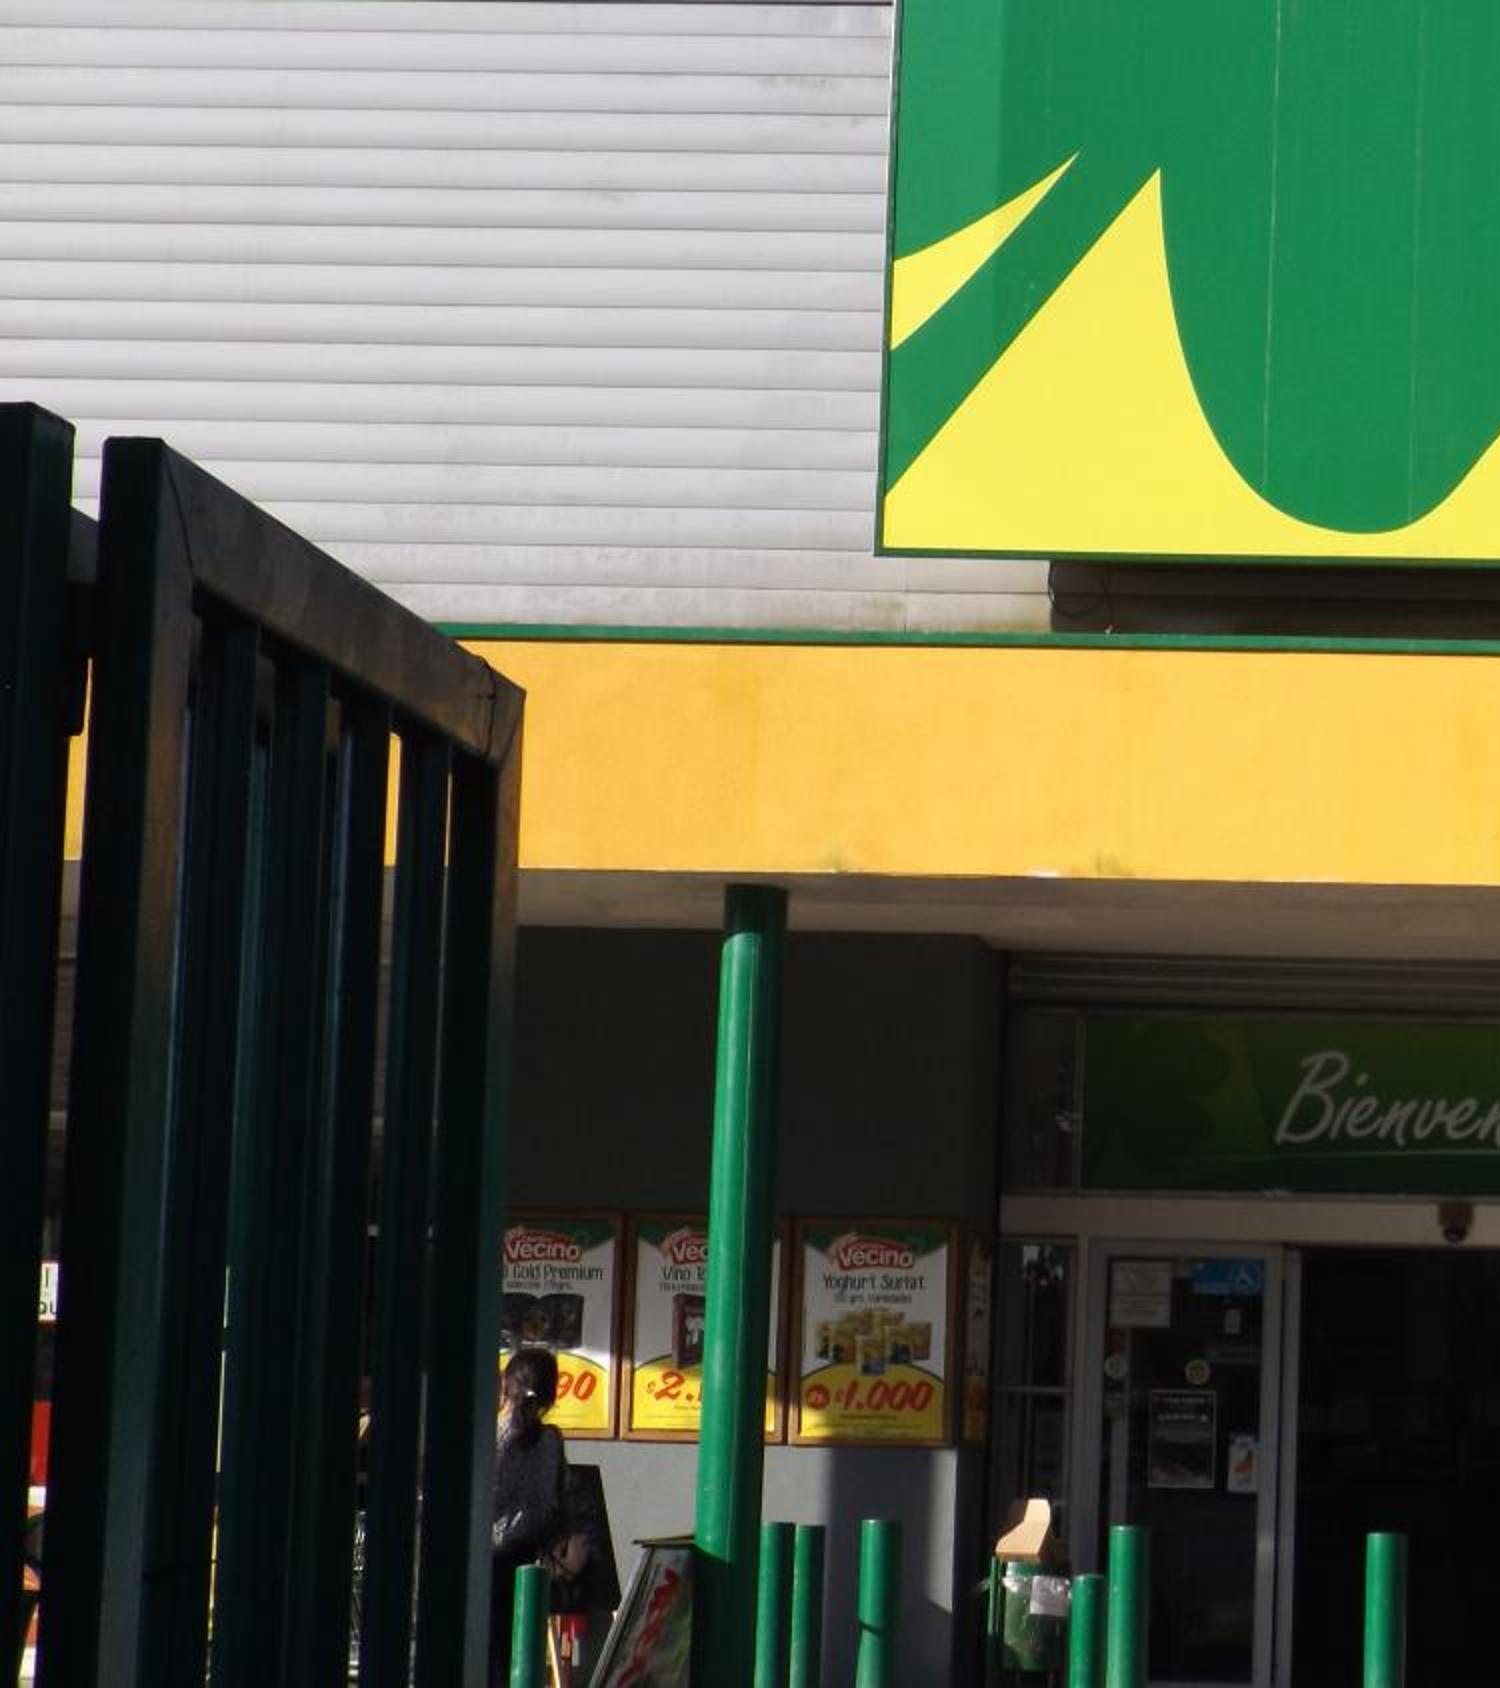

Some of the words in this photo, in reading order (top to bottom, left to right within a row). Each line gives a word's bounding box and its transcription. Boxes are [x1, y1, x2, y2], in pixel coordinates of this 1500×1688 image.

[505, 1239, 580, 1261] Vecino
[671, 1239, 709, 1260] Vec
[838, 1246, 913, 1267] Vecino
[543, 1264, 604, 1280] Premium
